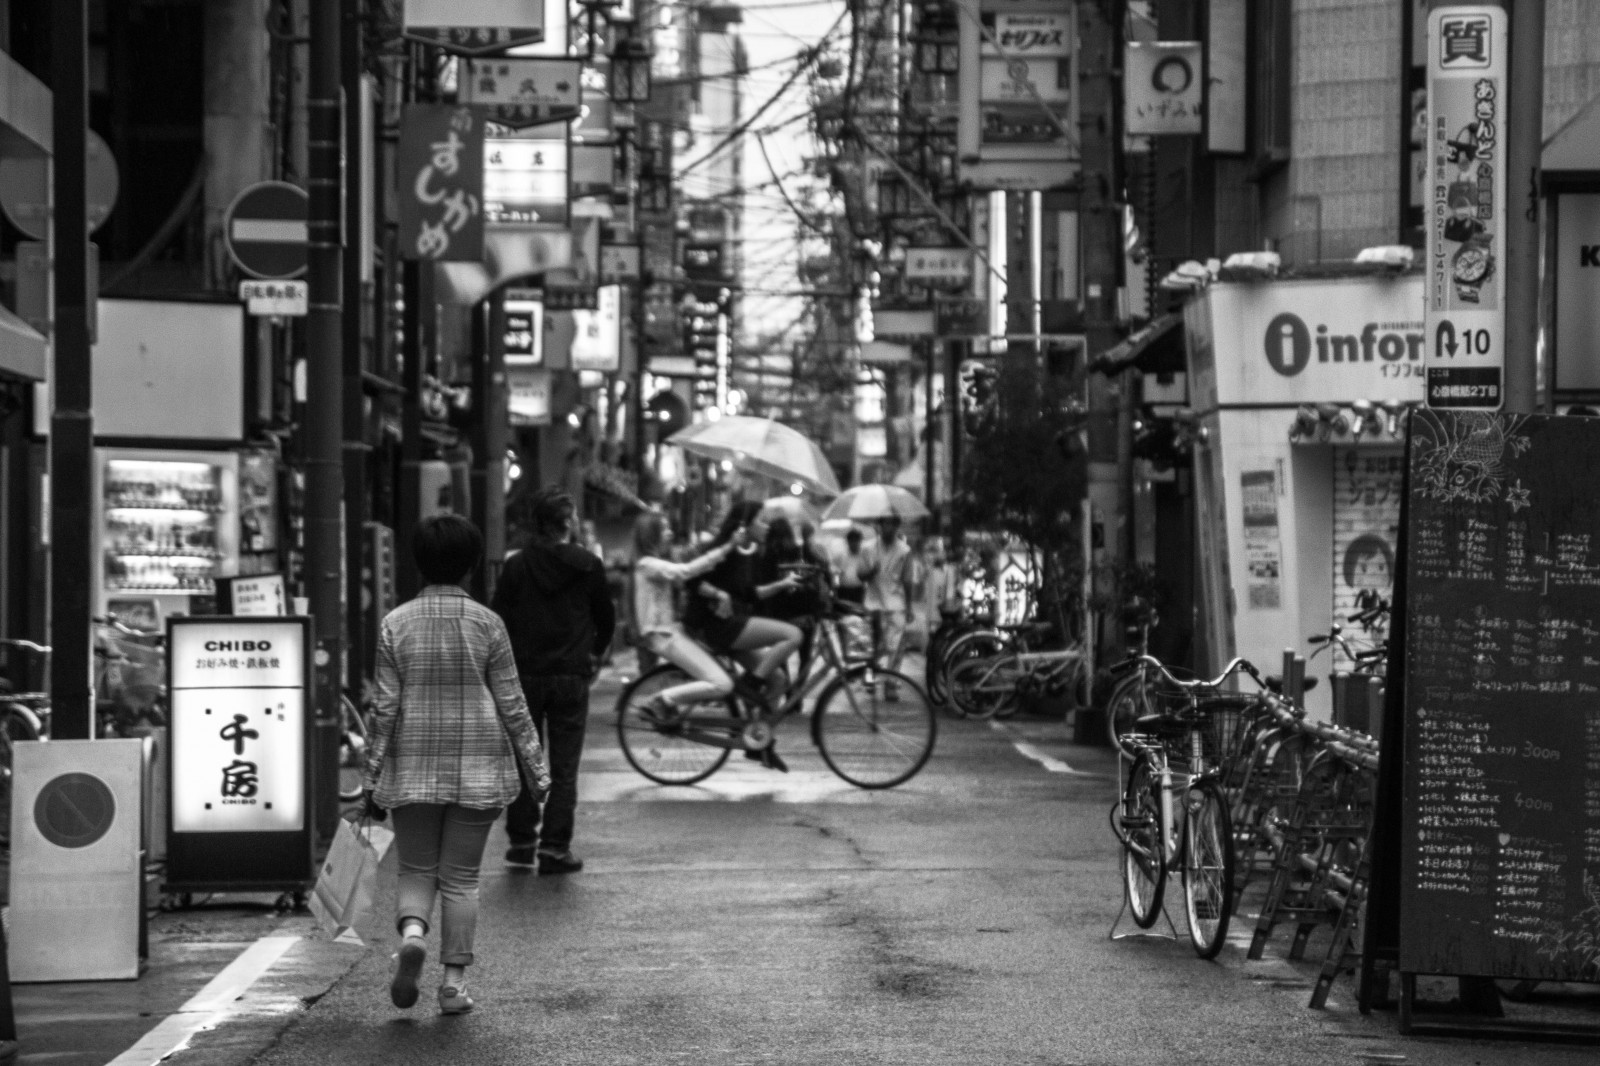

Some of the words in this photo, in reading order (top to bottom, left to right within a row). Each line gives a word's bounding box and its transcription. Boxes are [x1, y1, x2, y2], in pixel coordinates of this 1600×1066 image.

[1442, 20, 1489, 64] 質
[1462, 328, 1491, 355] 10
[204, 640, 272, 651] CHIBO
